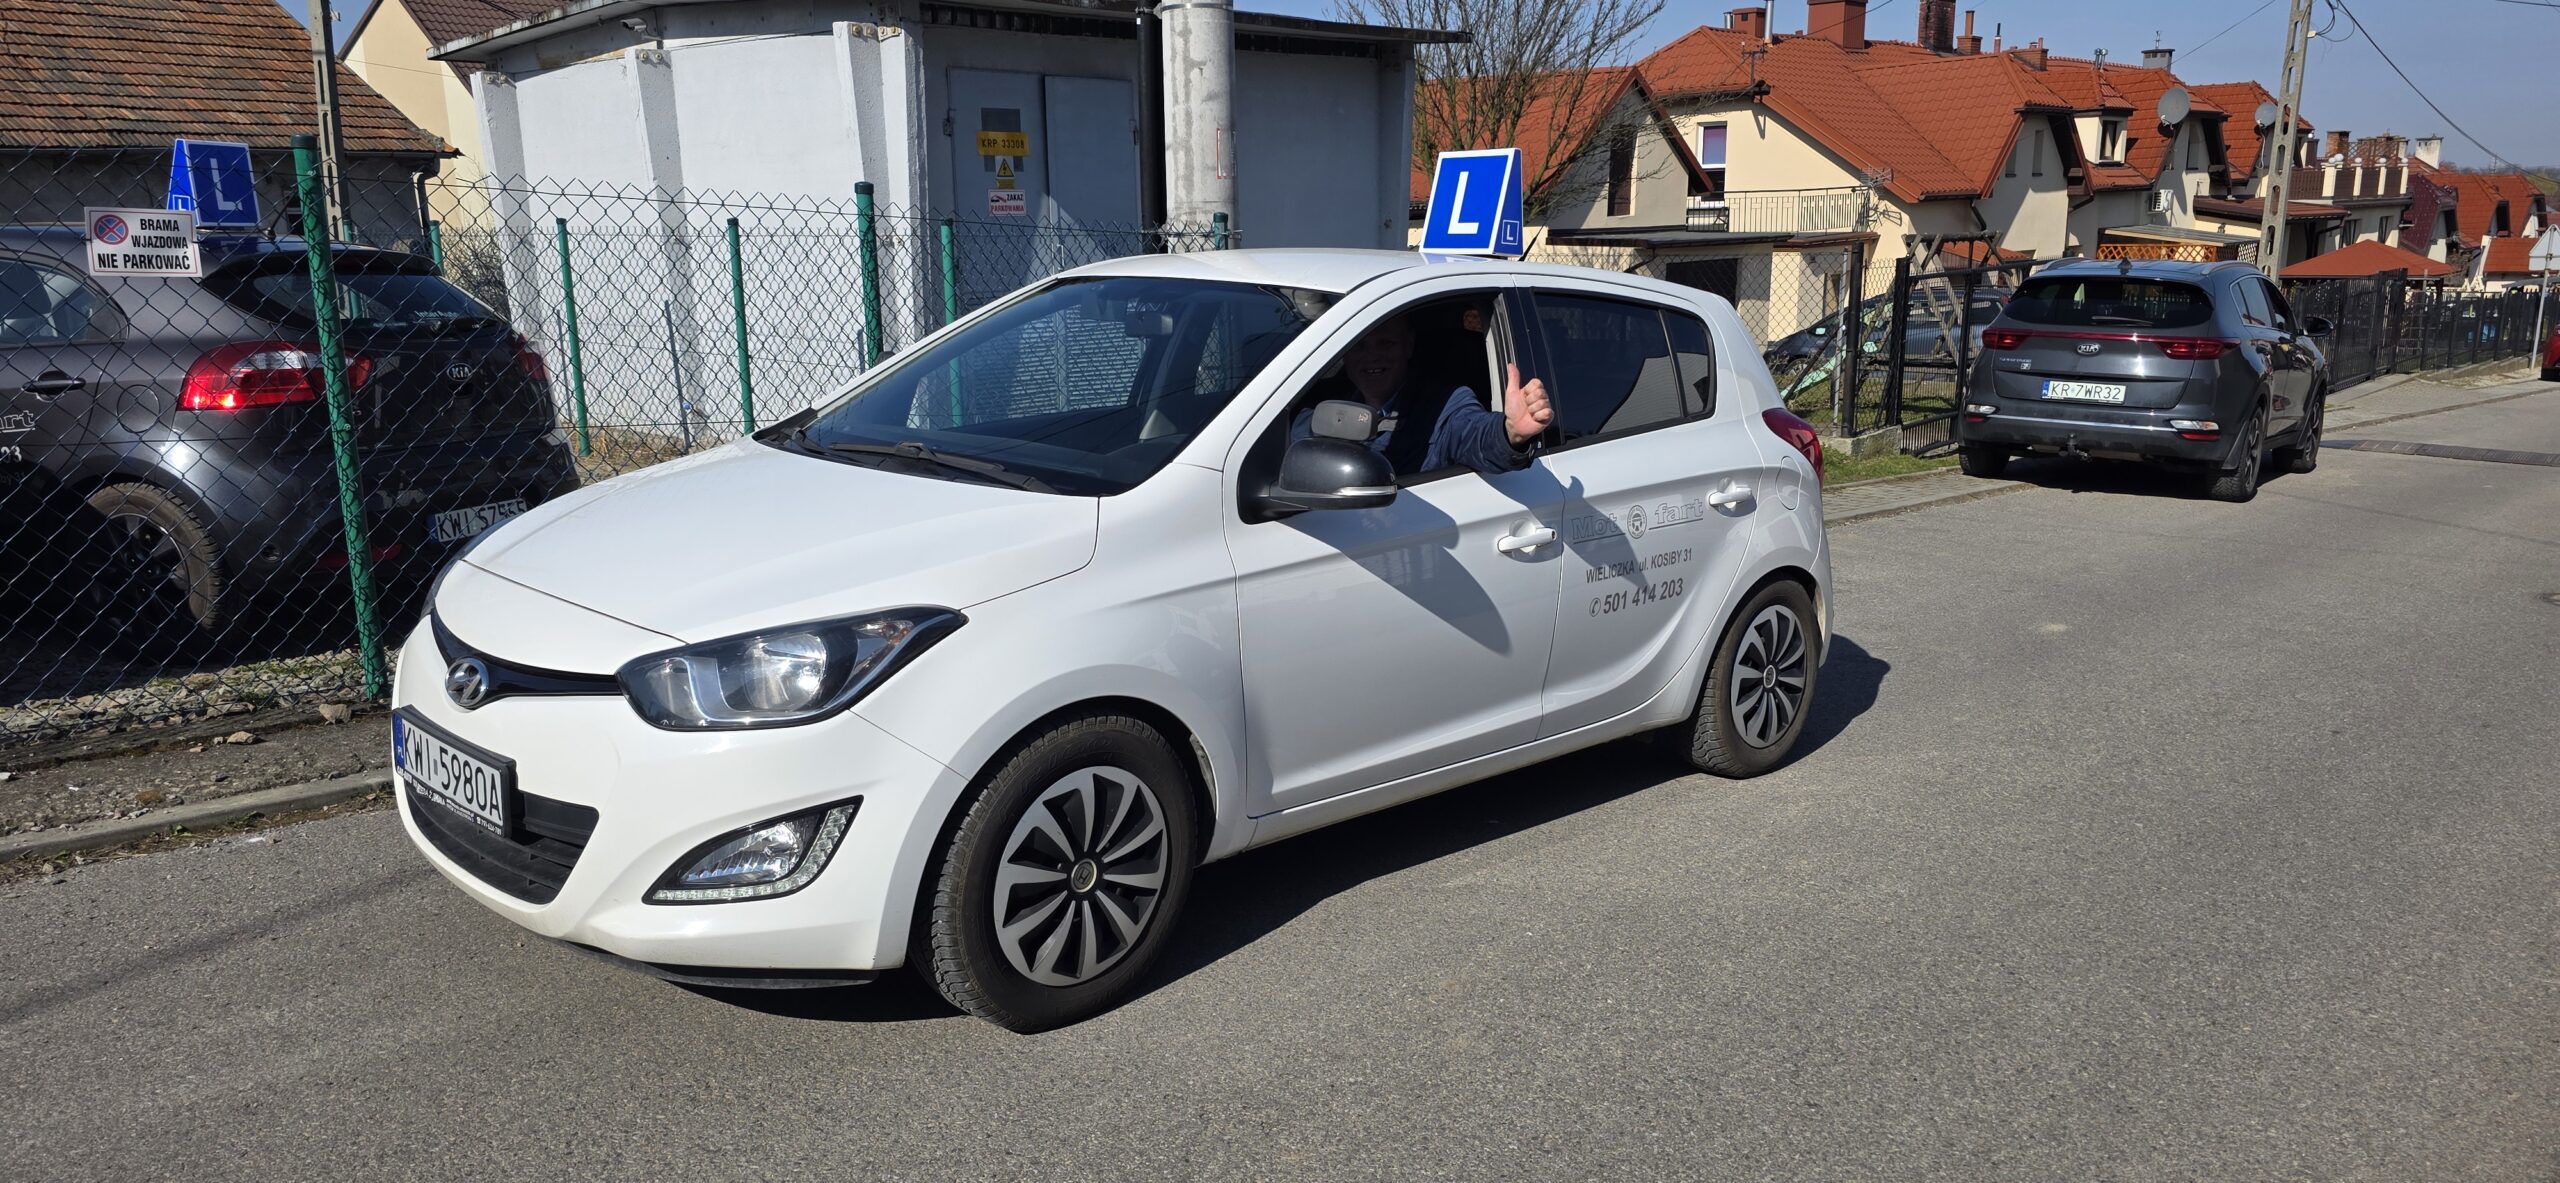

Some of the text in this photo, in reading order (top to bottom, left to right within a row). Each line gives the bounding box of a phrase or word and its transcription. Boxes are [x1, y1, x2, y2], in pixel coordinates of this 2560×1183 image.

[209, 157, 244, 211] L
[991, 204, 1024, 212] PARKOWANIA
[1006, 193, 1024, 201] ZAKAZ
[1447, 171, 1480, 234] L
[140, 218, 180, 232] BRAMA
[1506, 224, 1514, 240] L
[131, 235, 188, 249] WJAZDOWA
[97, 251, 190, 270] NIE PARKOWAĆ
[2051, 384, 2070, 397] KR
[2075, 384, 2121, 400] 7WR32
[437, 511, 471, 540] KWI
[1570, 512, 1618, 540] Mot
[1655, 499, 1704, 525] fart
[1586, 548, 1692, 584] WIELICZKA ul. KOSIBY 31
[1603, 578, 1683, 614] 501 414 203
[403, 723, 432, 781] KWI
[439, 746, 502, 822] 5980A
